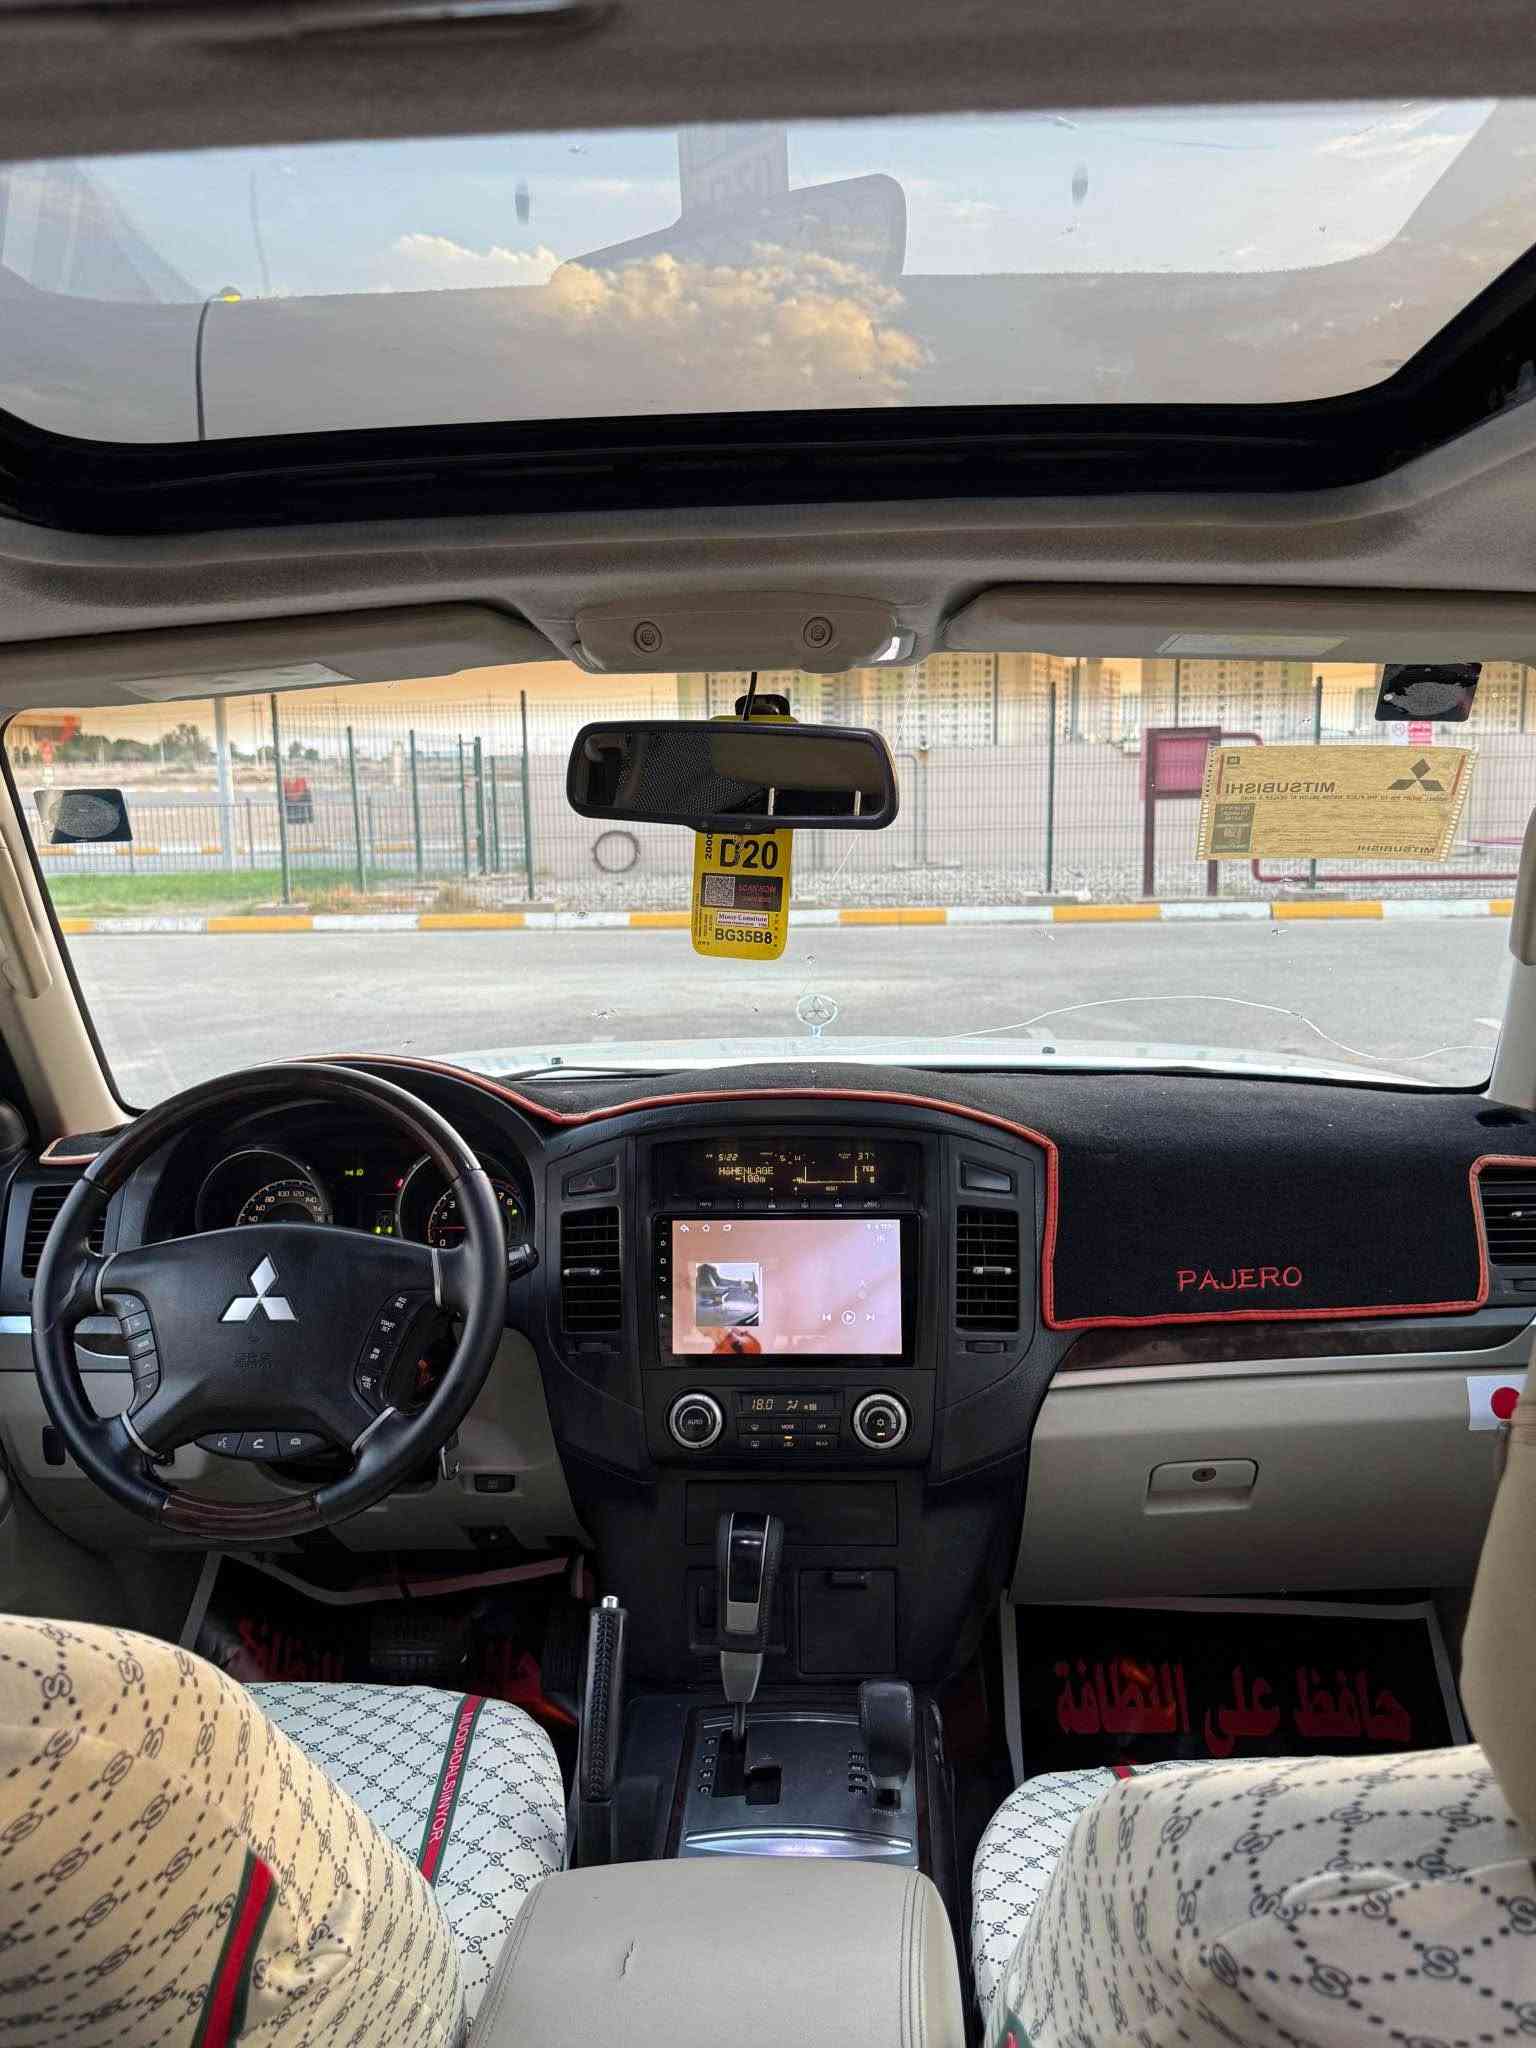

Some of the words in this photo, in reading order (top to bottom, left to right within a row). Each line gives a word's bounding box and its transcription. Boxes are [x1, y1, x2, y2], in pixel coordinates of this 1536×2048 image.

[720, 839, 778, 870] D20
[715, 928, 772, 944] BG35B8
[1176, 1265, 1303, 1292] PAJERO
